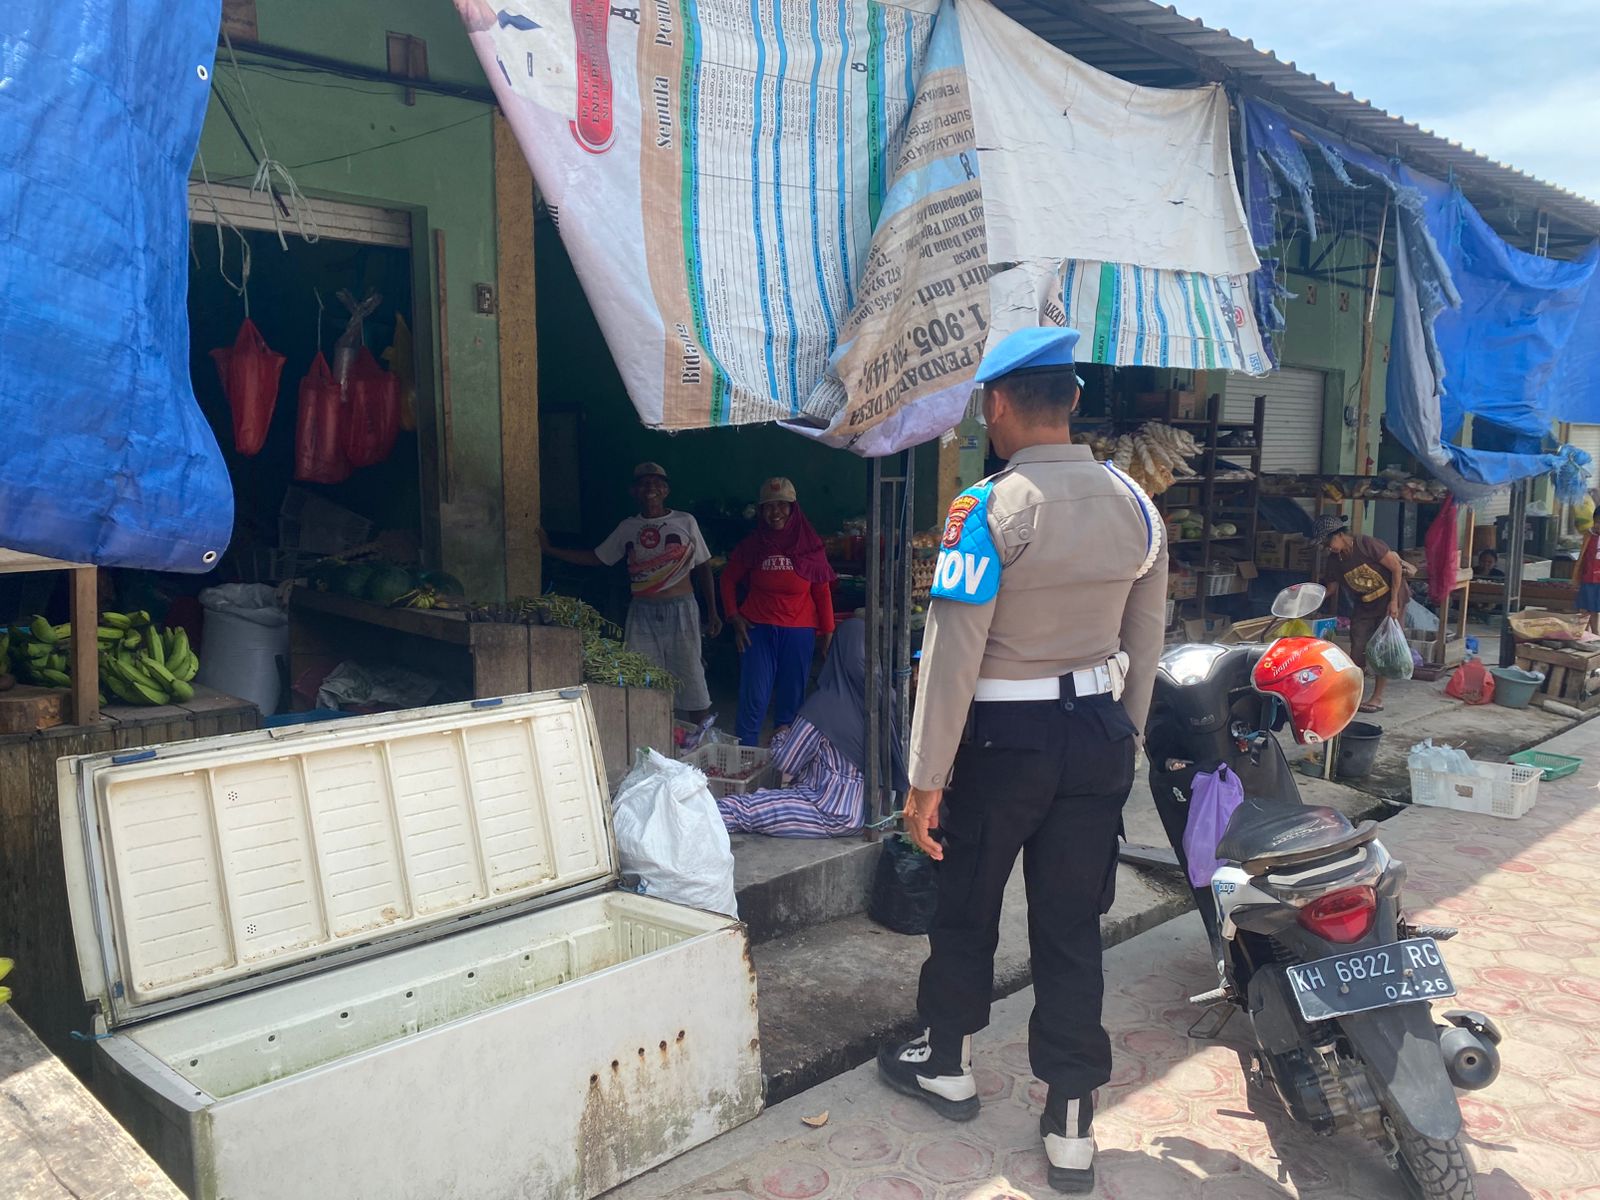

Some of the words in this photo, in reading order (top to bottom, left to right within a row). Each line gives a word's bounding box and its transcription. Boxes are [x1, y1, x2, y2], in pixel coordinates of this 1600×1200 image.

[653, 77, 672, 148] Semula
[933, 234, 963, 254] Dana
[953, 246, 980, 266] Desa
[917, 279, 956, 306] dari
[1293, 966, 1326, 992] KH
[1335, 952, 1396, 983] 6822
[1406, 943, 1440, 969] RG
